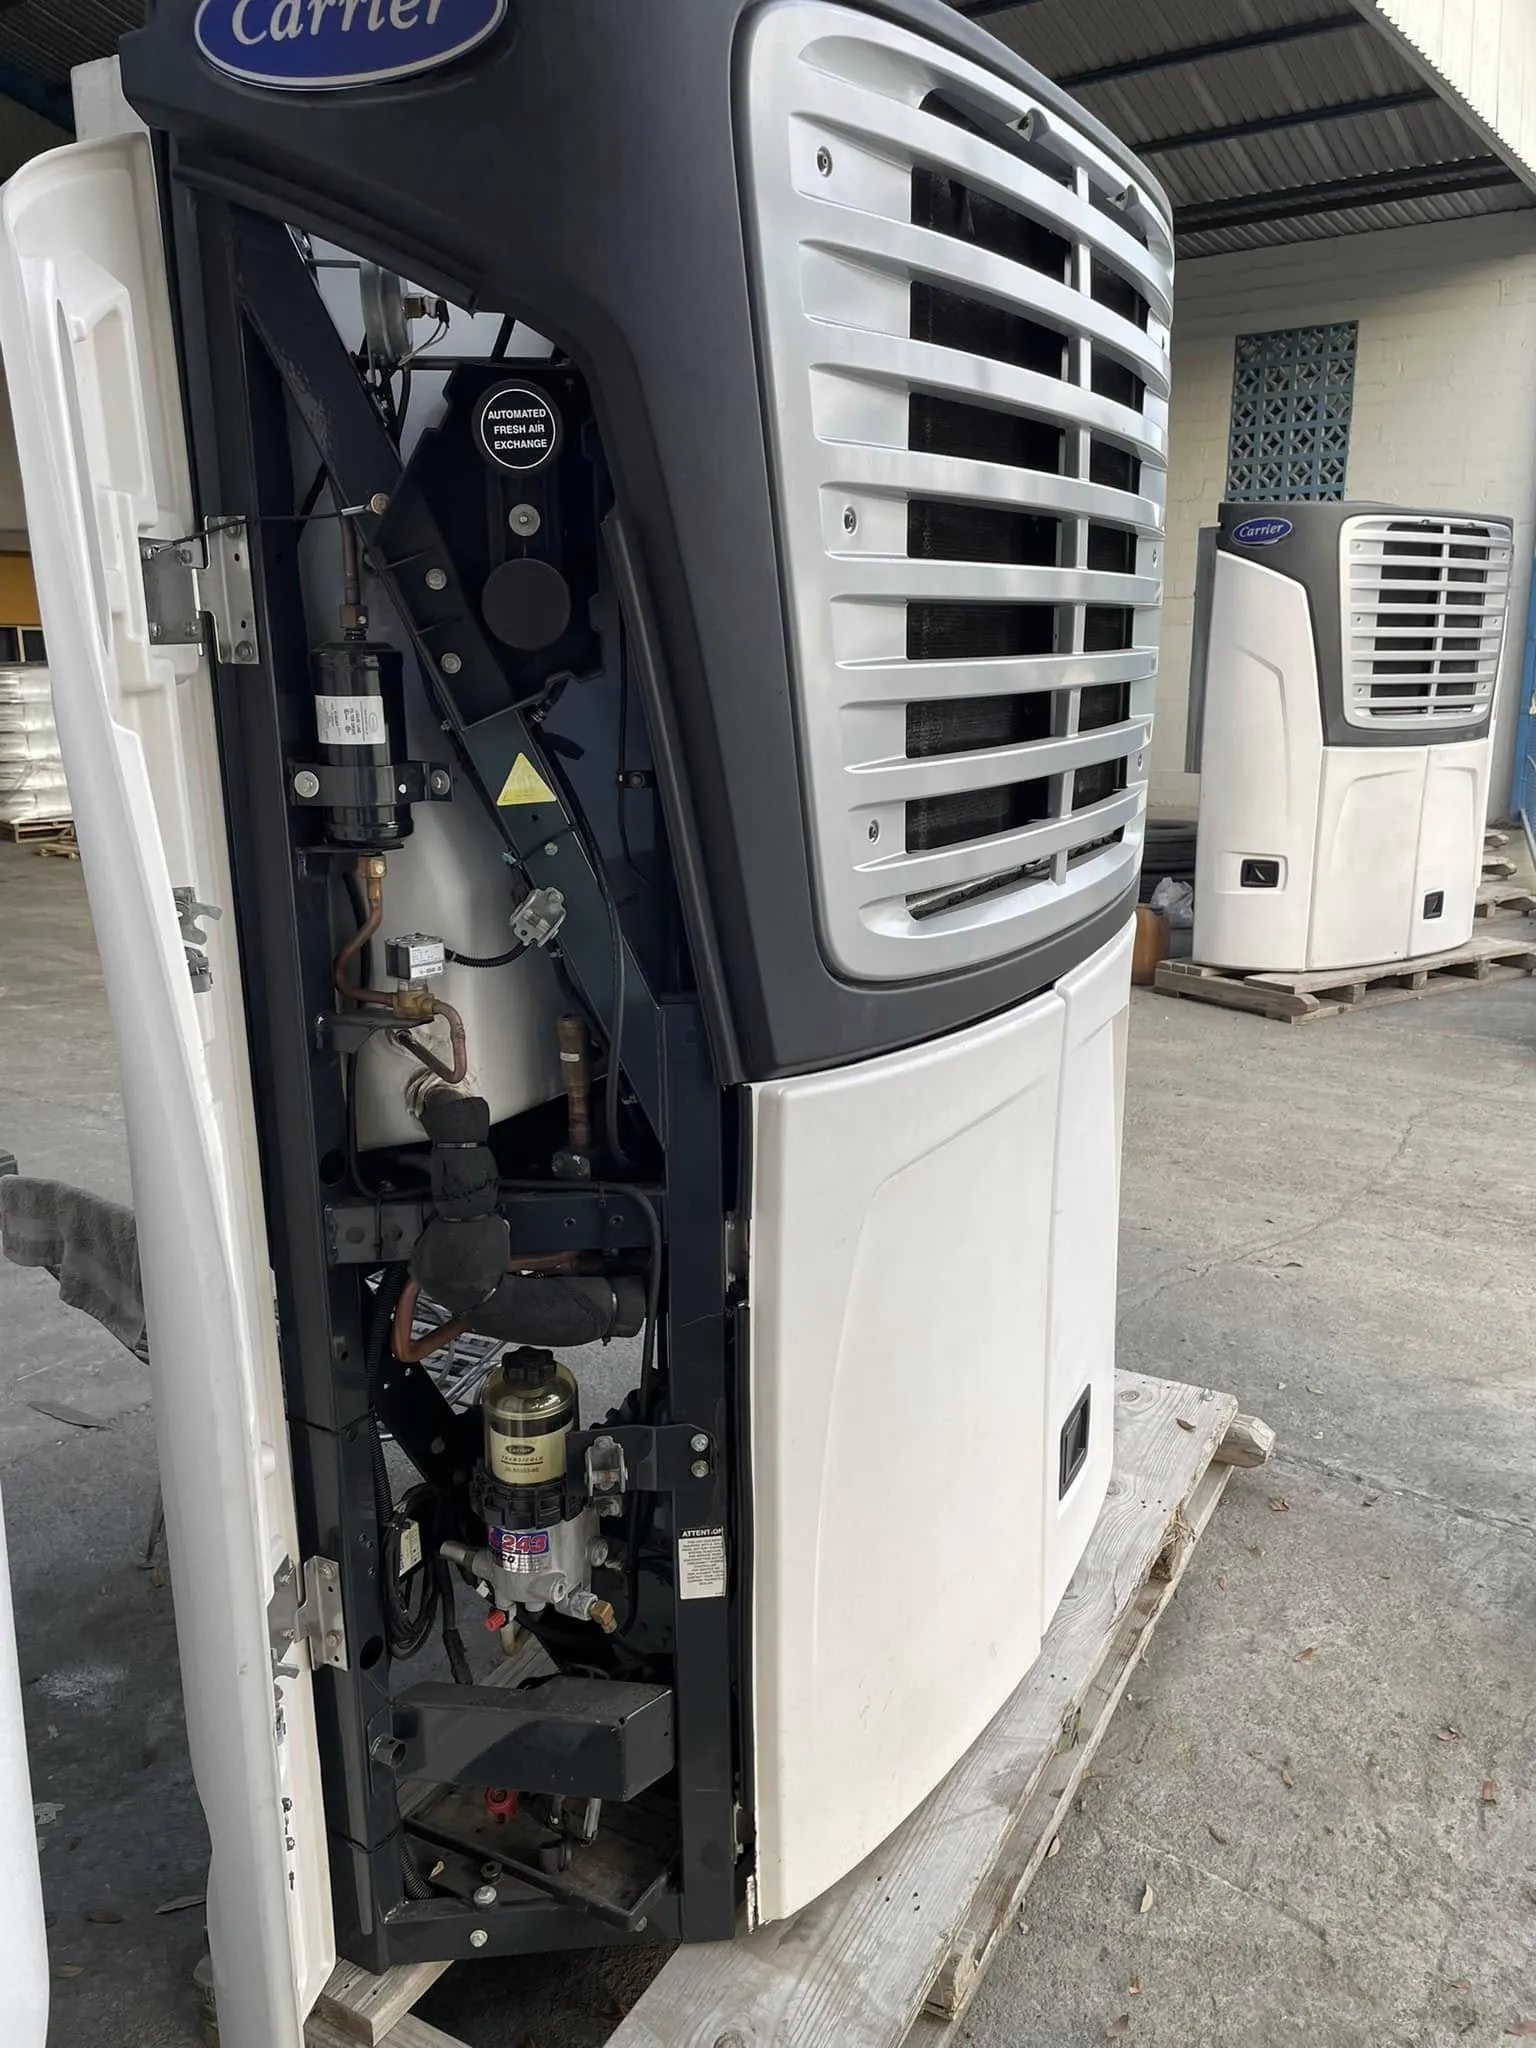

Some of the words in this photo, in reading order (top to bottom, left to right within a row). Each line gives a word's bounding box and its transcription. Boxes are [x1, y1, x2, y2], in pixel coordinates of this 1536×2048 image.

[488, 408, 546, 420] AUTOMATED
[494, 424, 526, 435] FRESH
[528, 424, 545, 433] AIR
[494, 439, 548, 450] EXCHANGE
[1239, 523, 1284, 538] Carrier
[502, 1533, 547, 1553] 243
